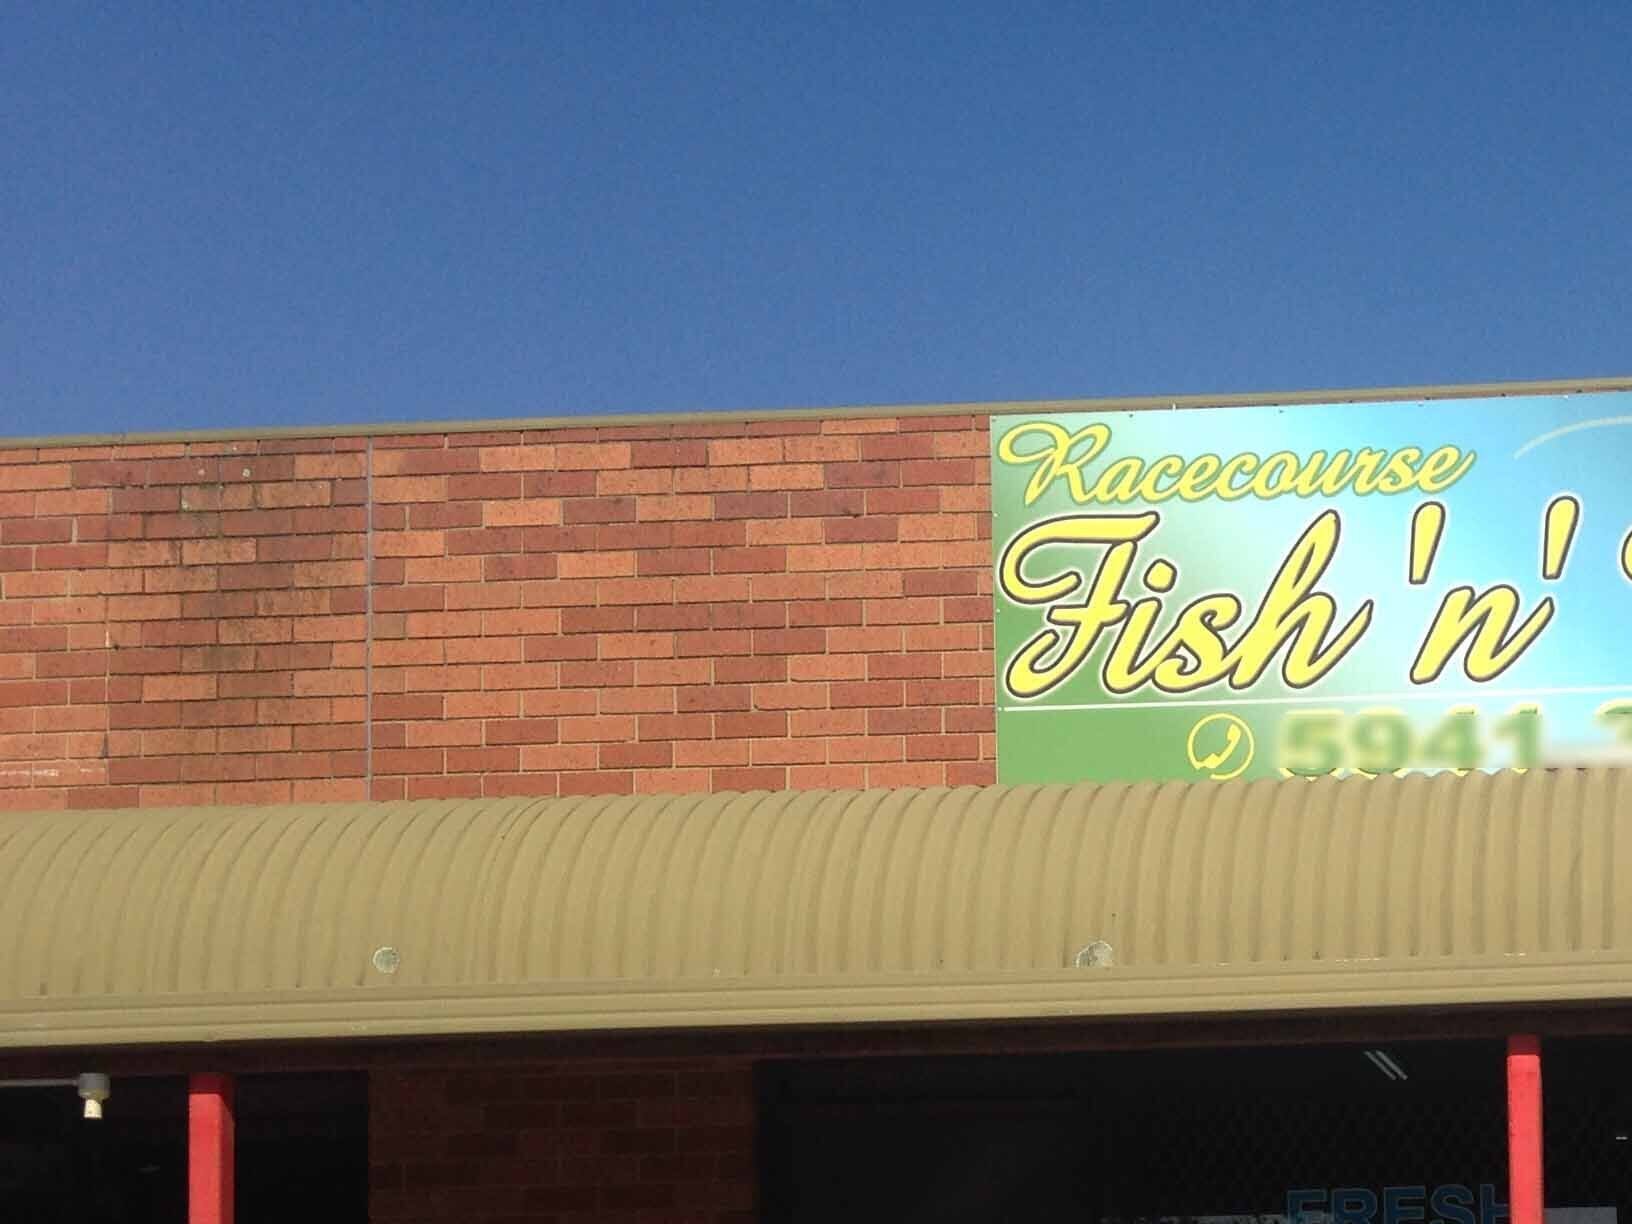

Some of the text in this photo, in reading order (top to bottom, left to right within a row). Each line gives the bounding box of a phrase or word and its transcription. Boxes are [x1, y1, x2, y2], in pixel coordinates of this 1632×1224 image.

[998, 421, 1474, 507] Racecourse
[1000, 505, 1376, 699] Fish
[1407, 495, 1580, 685] 'n'
